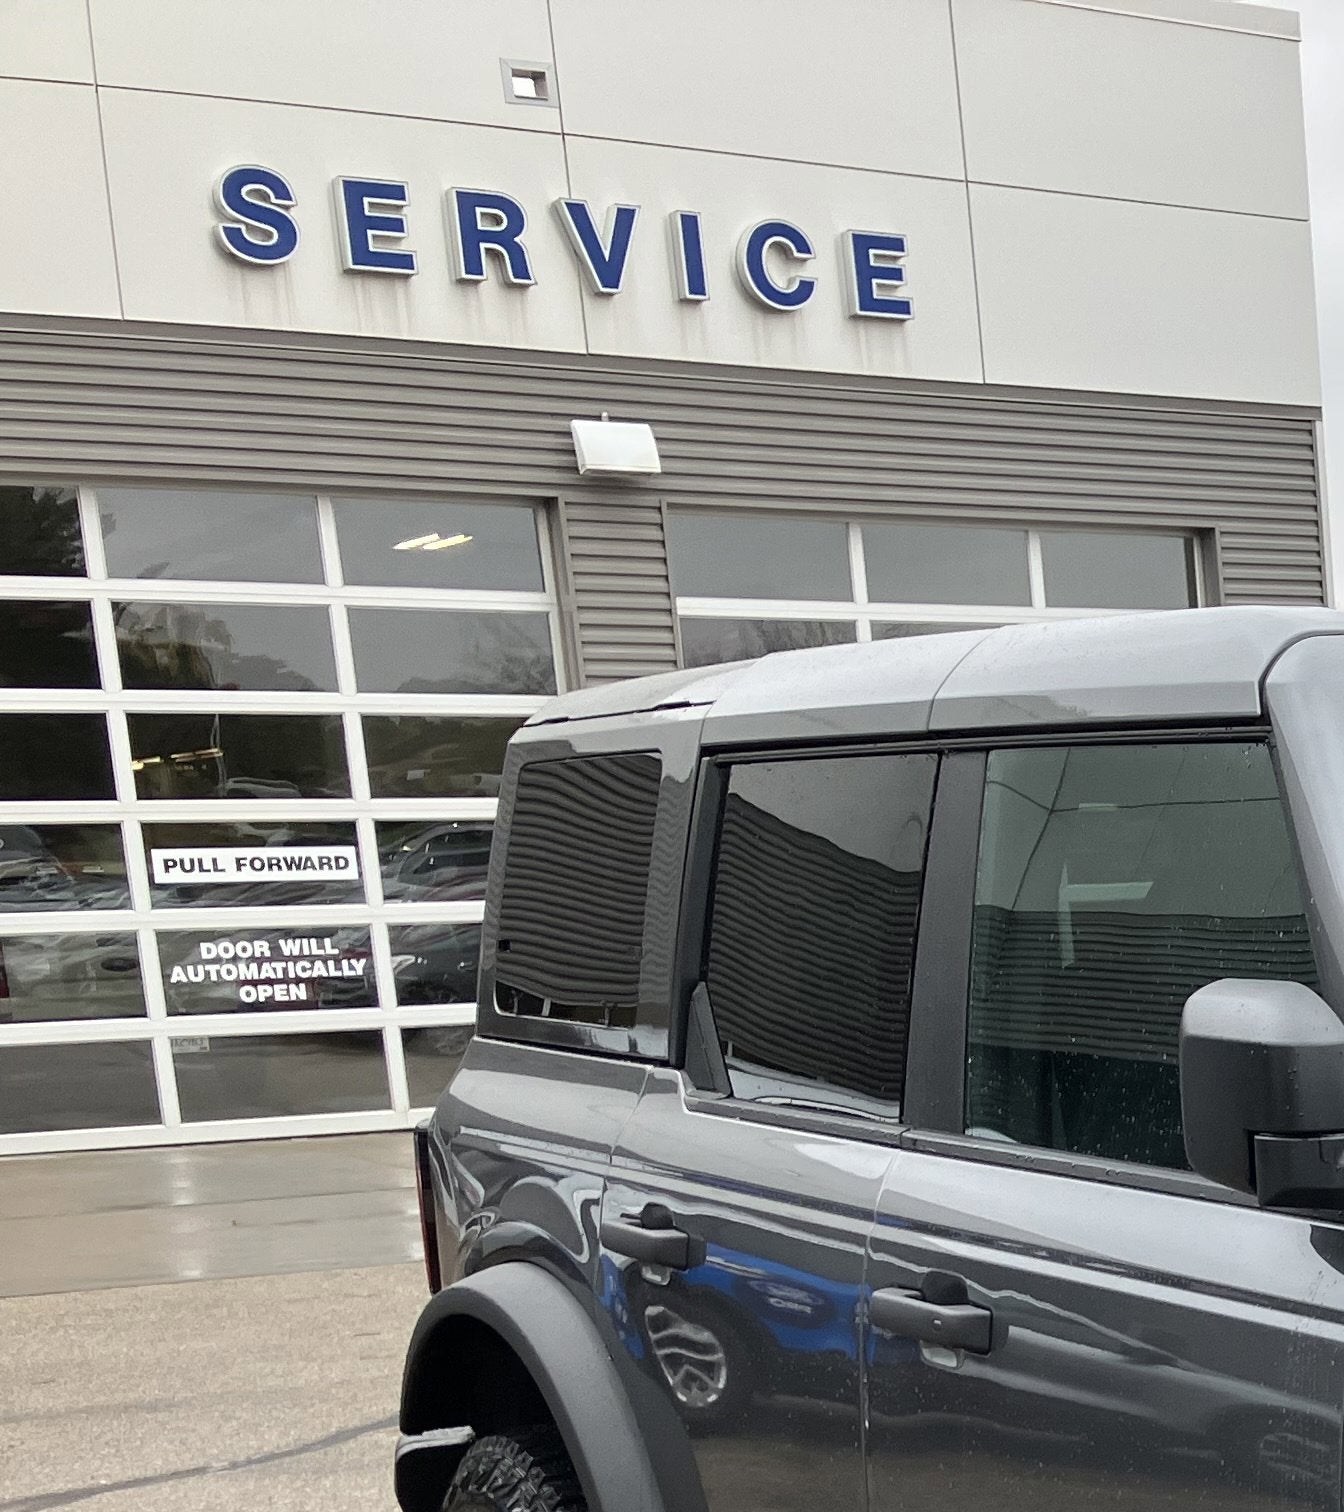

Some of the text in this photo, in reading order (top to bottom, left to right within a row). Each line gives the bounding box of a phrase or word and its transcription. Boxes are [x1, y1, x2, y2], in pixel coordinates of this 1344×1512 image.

[212, 164, 914, 321] SERVICE
[163, 855, 350, 874] PULL FORWARD
[200, 938, 339, 960] DOOR WILL
[170, 958, 367, 984] AUTOMATICALLY
[239, 983, 307, 1003] OPEN
